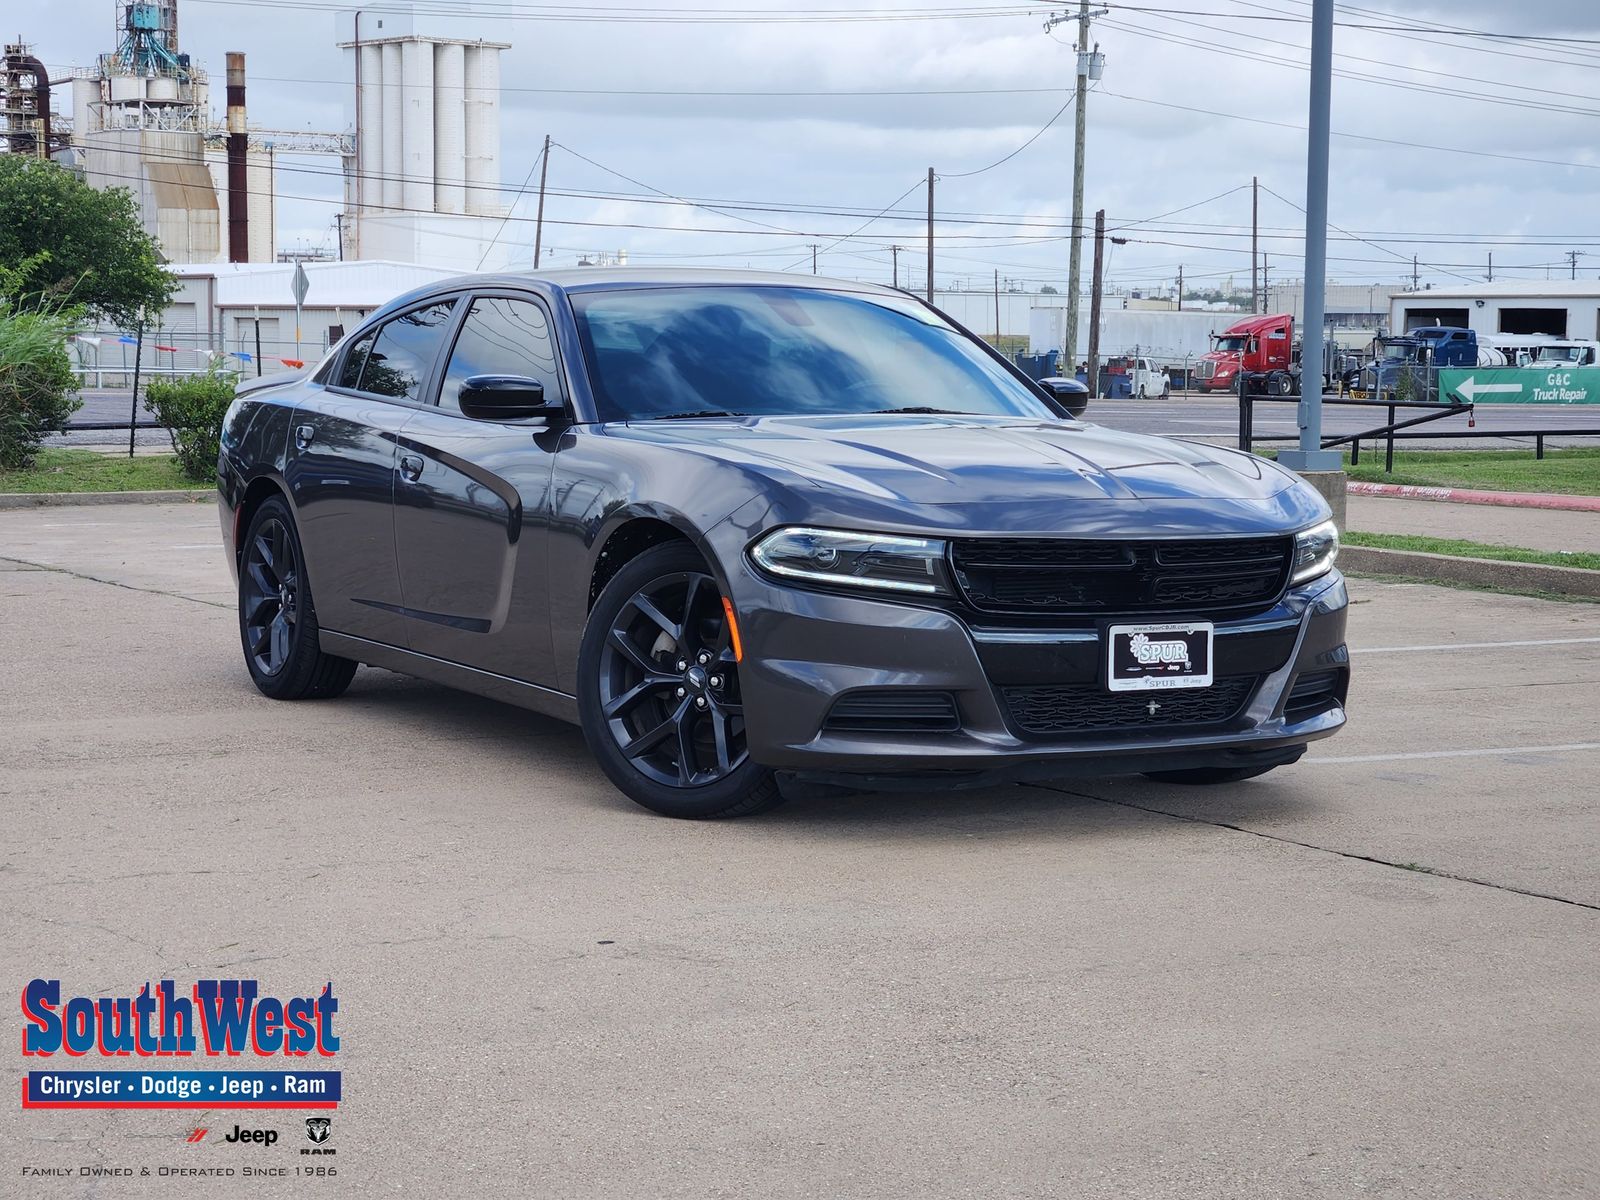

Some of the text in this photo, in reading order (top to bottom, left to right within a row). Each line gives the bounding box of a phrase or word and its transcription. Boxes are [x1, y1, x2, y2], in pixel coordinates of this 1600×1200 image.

[1547, 373, 1571, 386] G&C
[1533, 387, 1587, 403] Truck Repair
[1140, 643, 1187, 661] SPUR
[1149, 680, 1176, 688] SPUR
